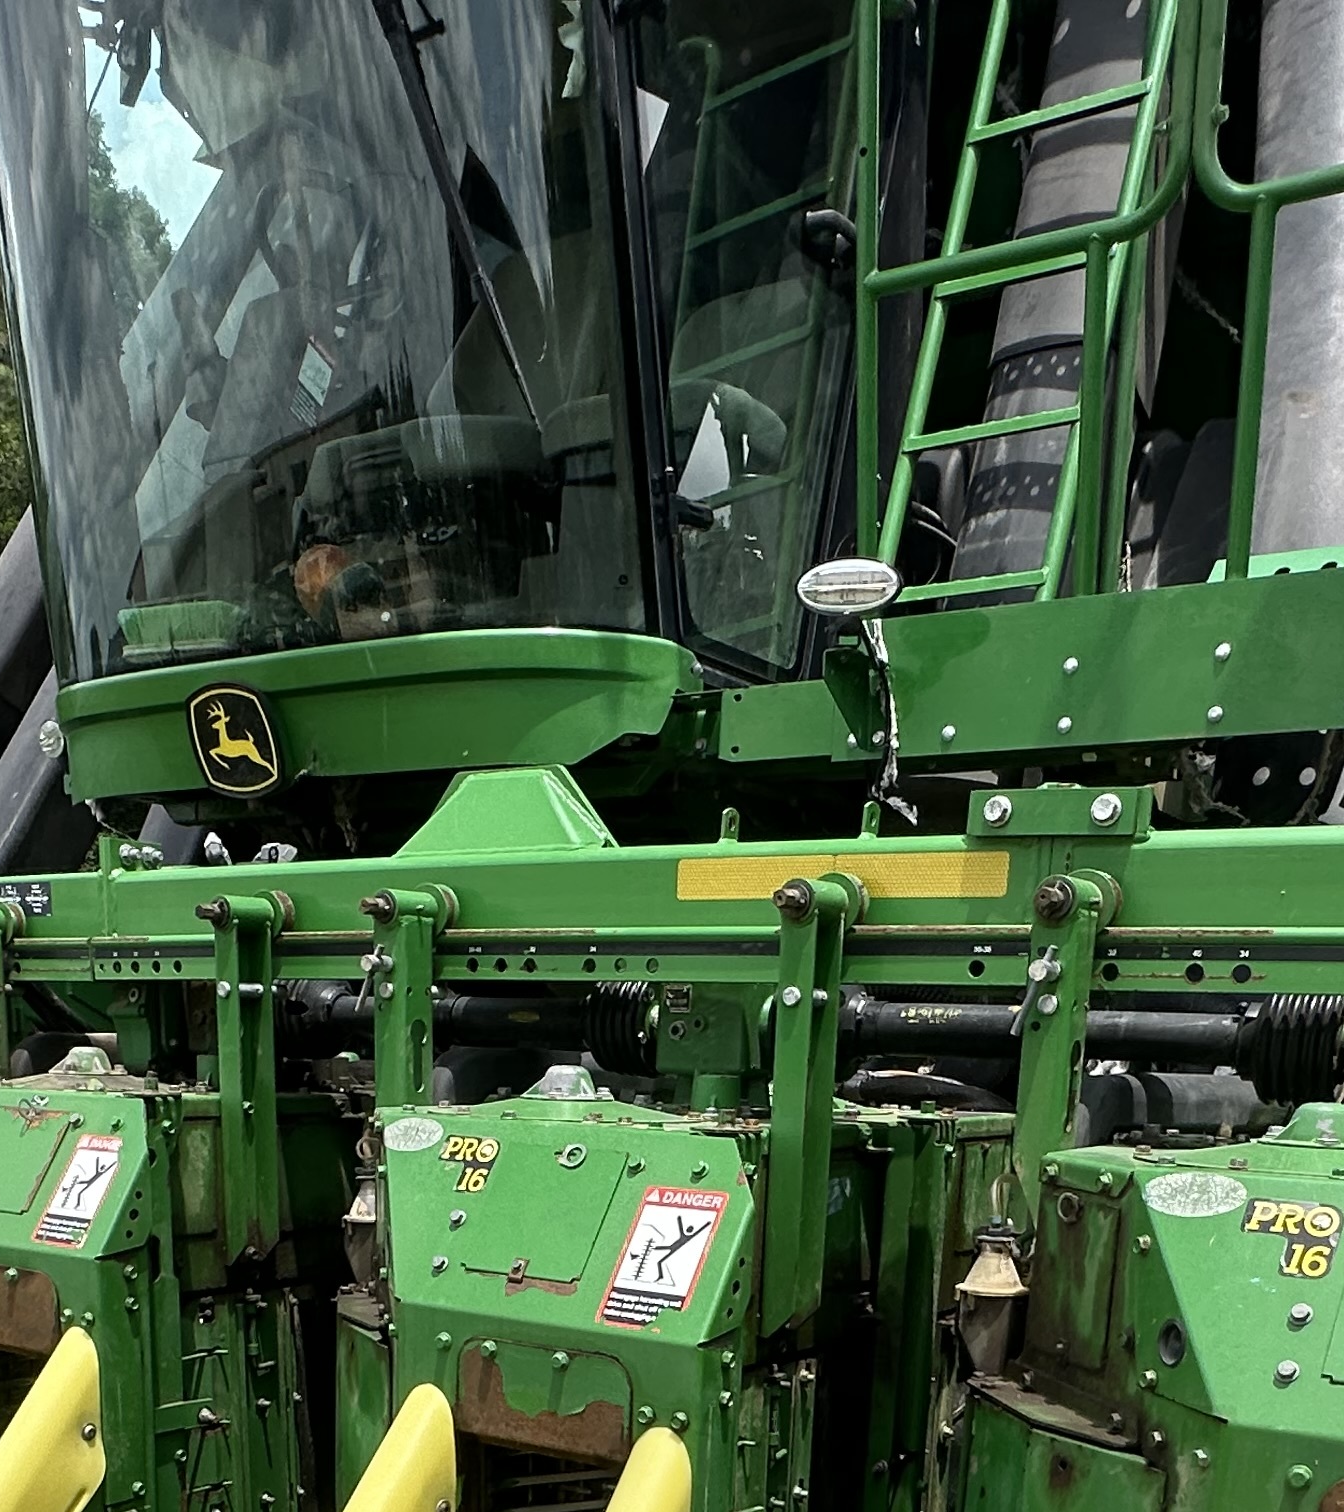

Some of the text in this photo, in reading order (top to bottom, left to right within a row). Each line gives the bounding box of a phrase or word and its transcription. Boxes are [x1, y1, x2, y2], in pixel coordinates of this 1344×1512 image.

[441, 1136, 499, 1163] PRO
[458, 1167, 489, 1192] 16
[662, 1190, 724, 1209] DANGER
[1244, 1201, 1340, 1237] PRO
[1284, 1243, 1331, 1277] 16
